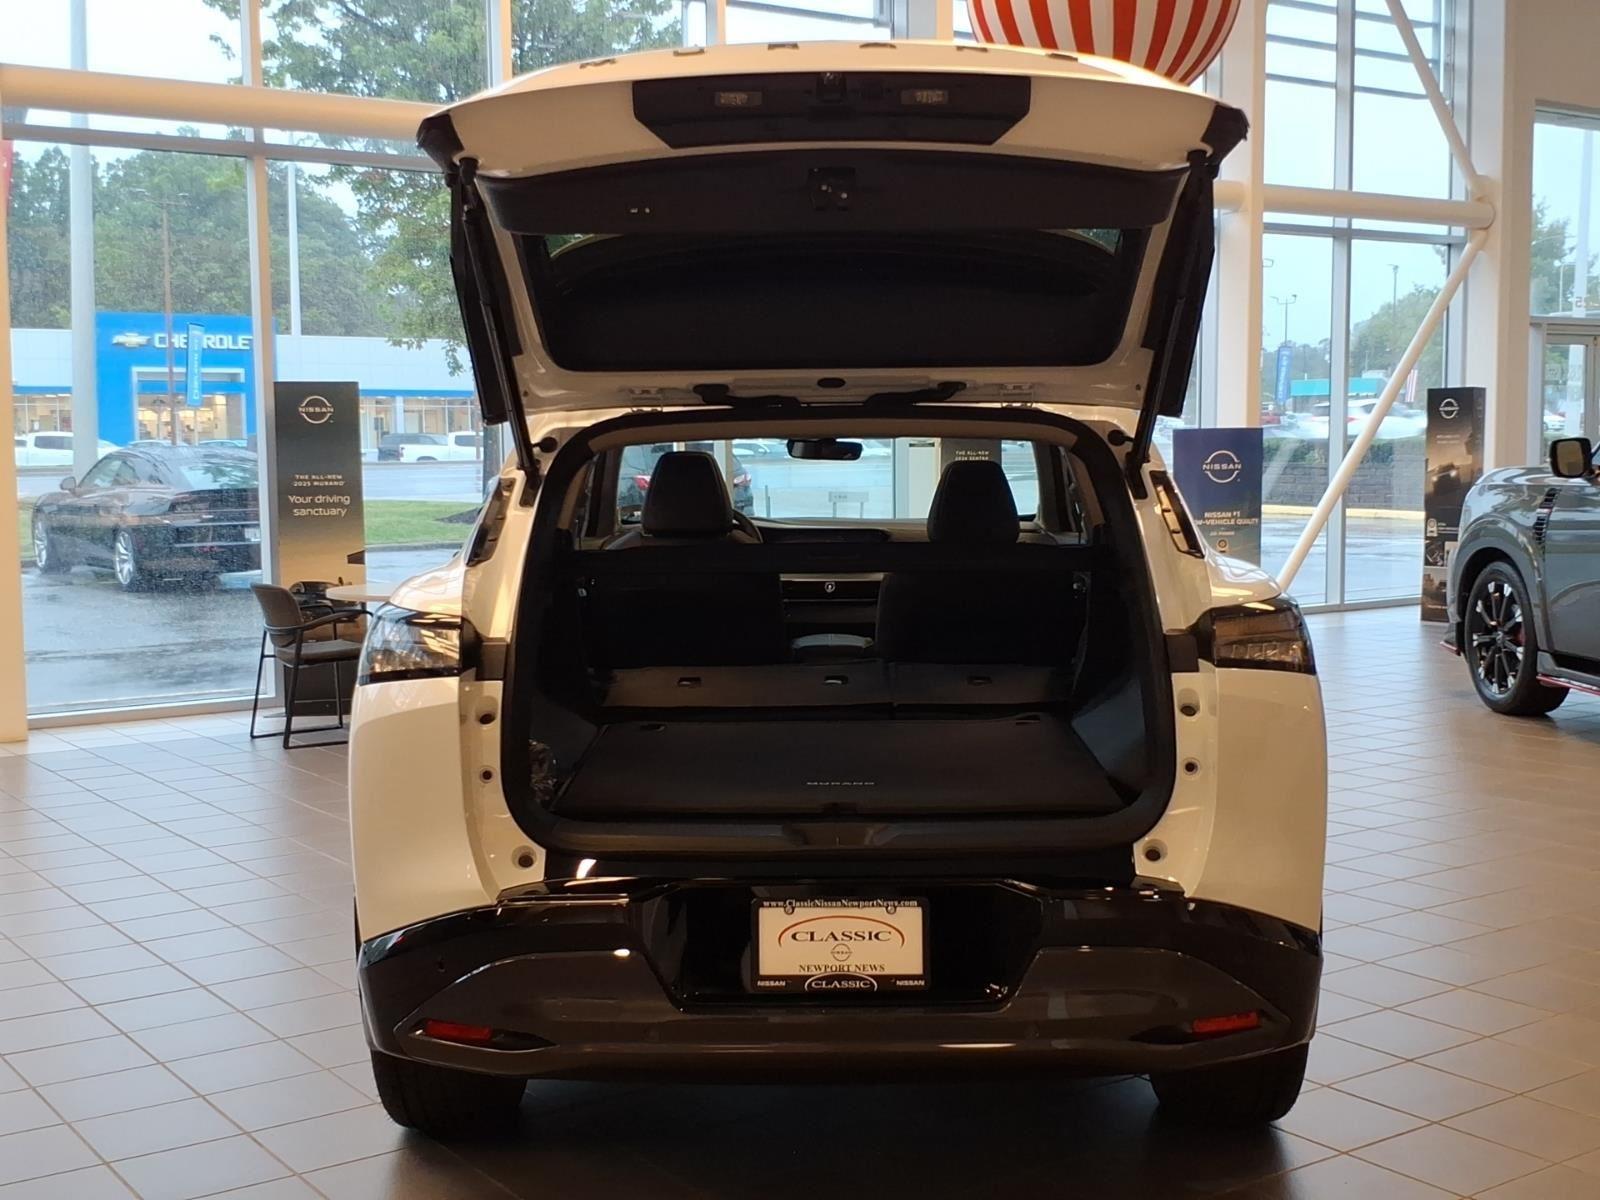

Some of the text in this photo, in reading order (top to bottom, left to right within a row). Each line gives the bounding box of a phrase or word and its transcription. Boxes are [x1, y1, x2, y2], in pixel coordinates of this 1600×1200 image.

[153, 333, 253, 350] CHEROLE
[1202, 463, 1242, 471] NISSAN
[288, 494, 351, 505] Your driving
[293, 507, 348, 518] sanctuary
[790, 930, 893, 942] CLASSIC
[799, 963, 886, 973] NEWPORT NEWS
[811, 980, 872, 989] CLASSIC
